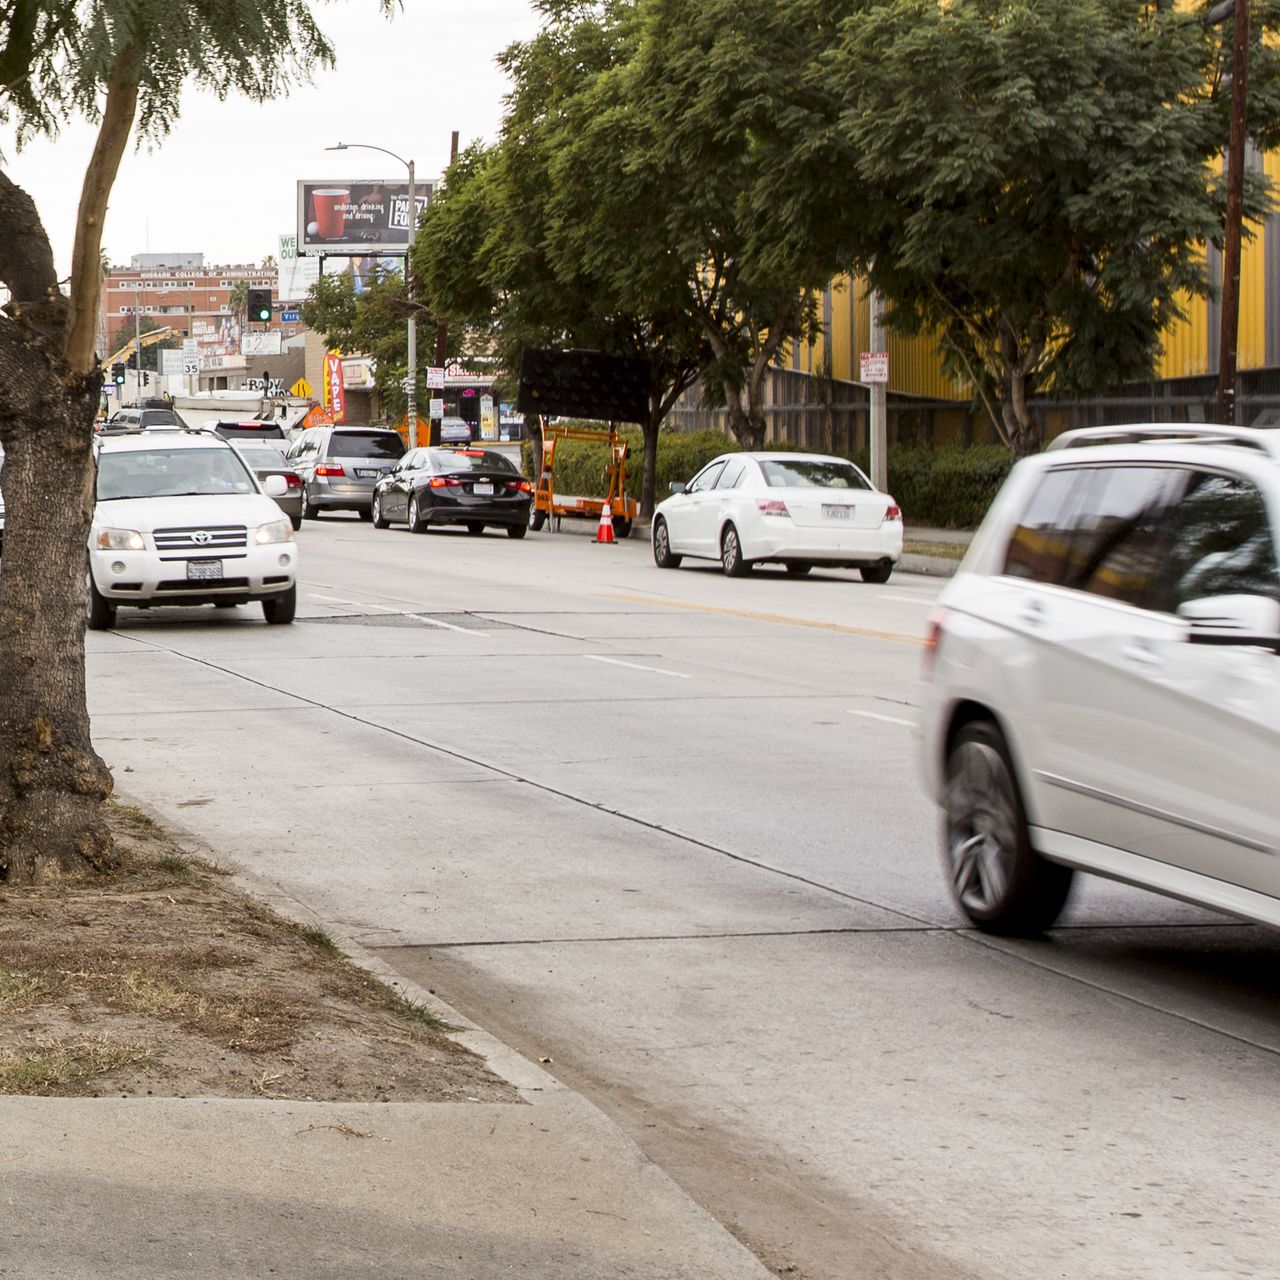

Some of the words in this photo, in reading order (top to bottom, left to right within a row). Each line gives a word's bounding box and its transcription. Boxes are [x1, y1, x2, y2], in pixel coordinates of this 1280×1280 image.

[395, 199, 423, 214] PAY
[281, 236, 296, 248] WE
[281, 249, 298, 259] OU
[185, 365, 198, 373] 35
[329, 359, 341, 411] VAPE
